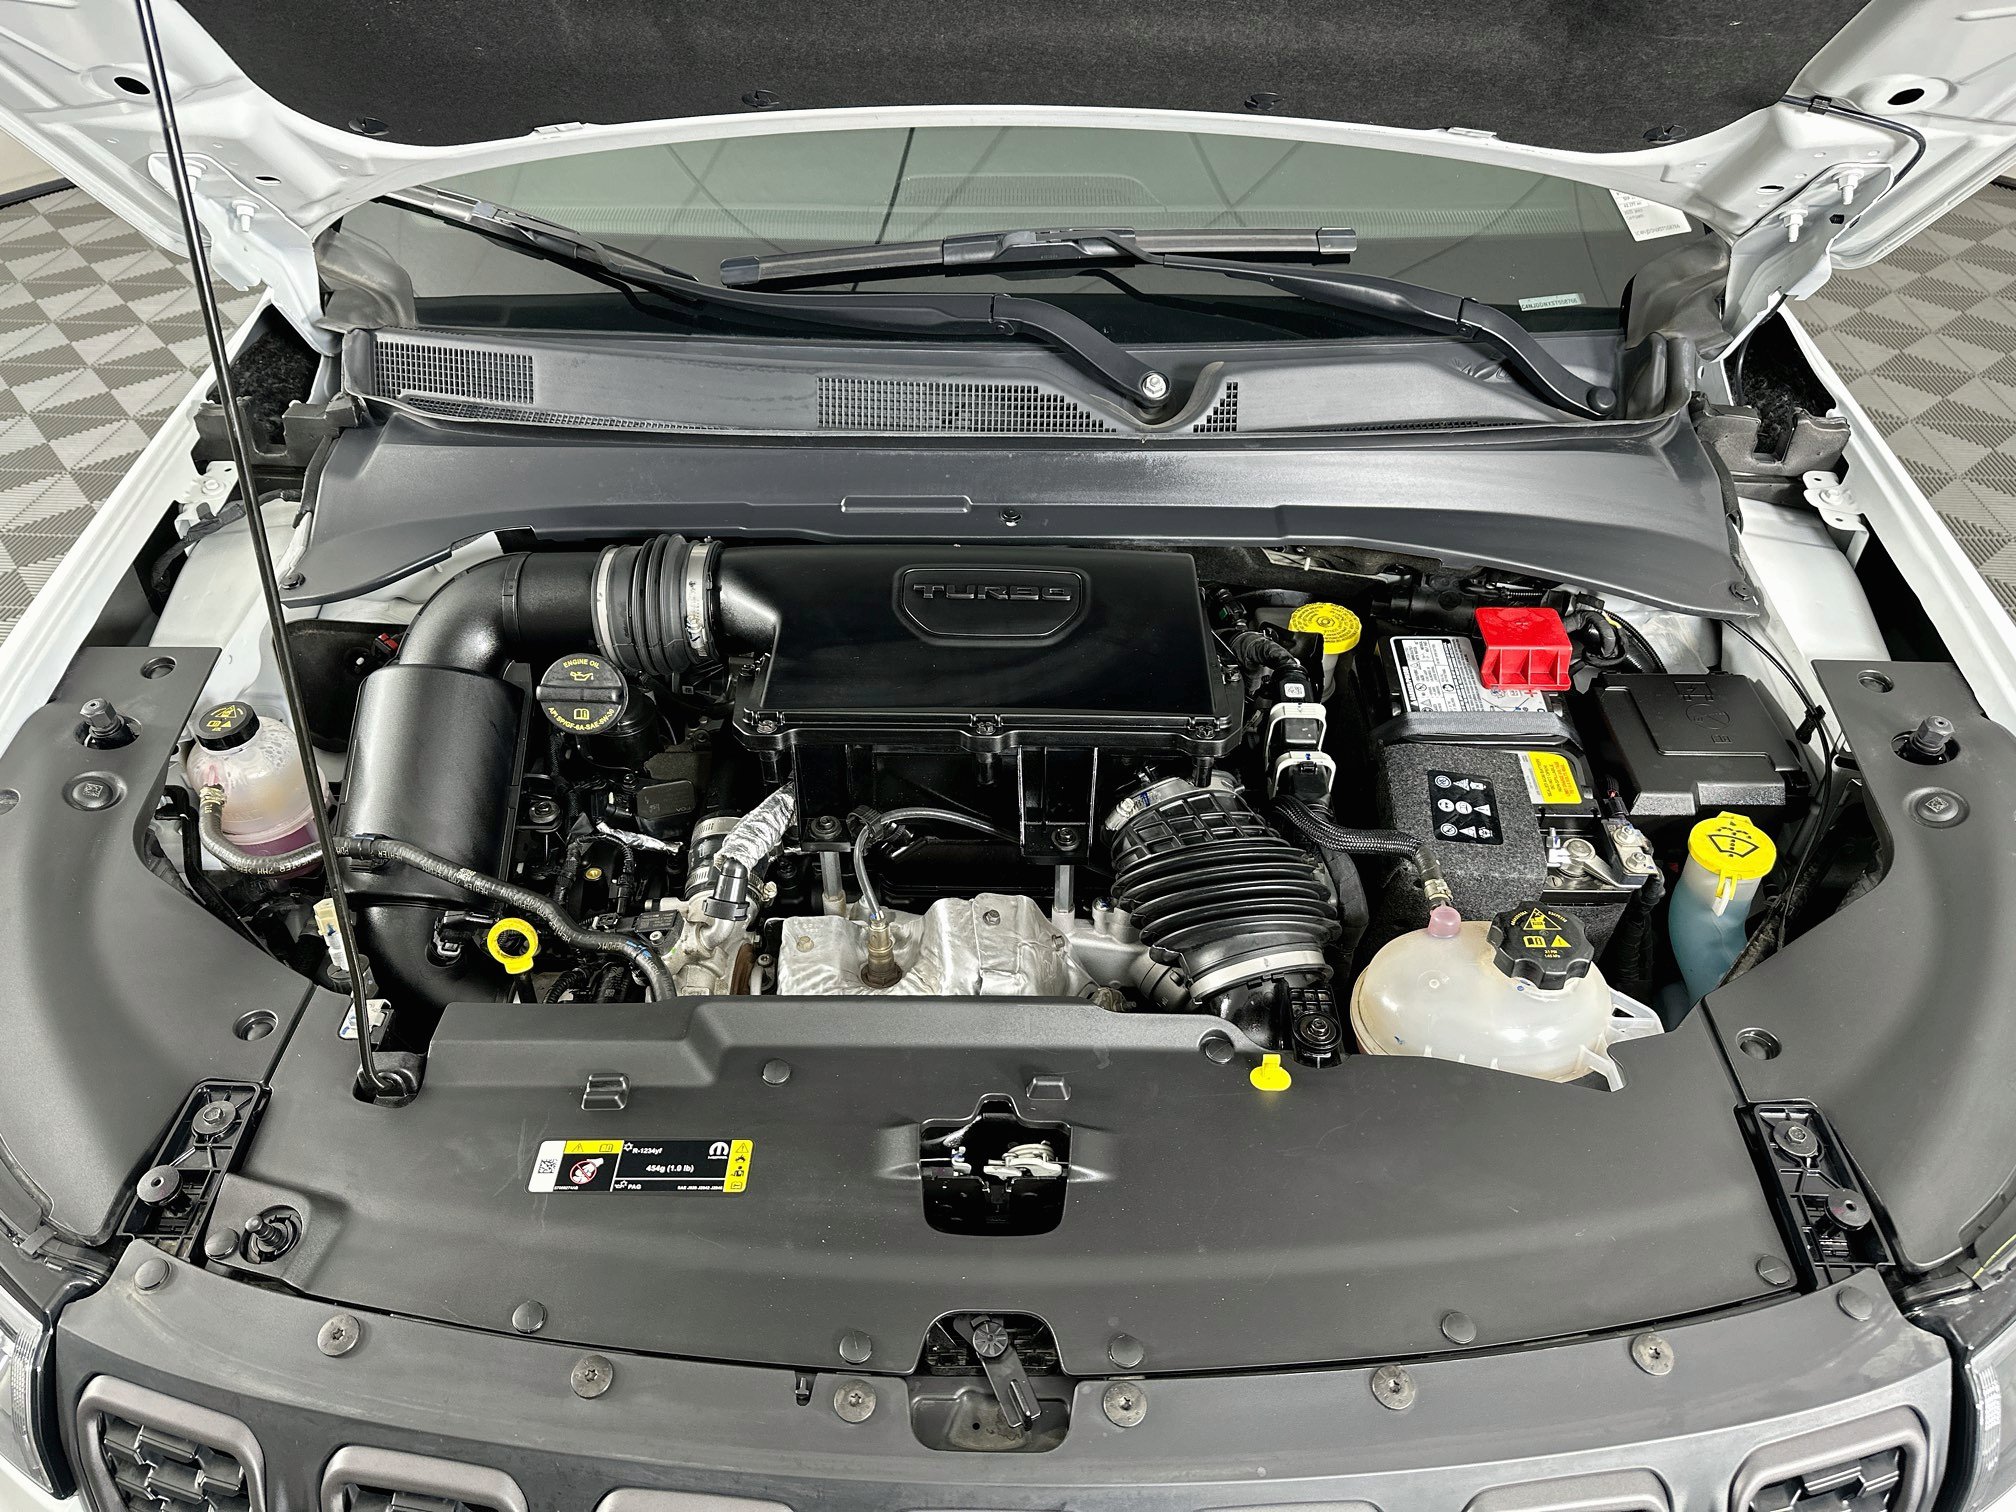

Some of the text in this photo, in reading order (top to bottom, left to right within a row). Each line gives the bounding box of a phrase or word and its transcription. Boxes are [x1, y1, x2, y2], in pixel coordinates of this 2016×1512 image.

[912, 583, 1073, 602] TURBO
[563, 659, 600, 670] ENGINE OIL
[548, 707, 558, 718] API
[632, 1147, 663, 1155] R-1234yf
[645, 1164, 694, 1173] 454g (1.0 lb)
